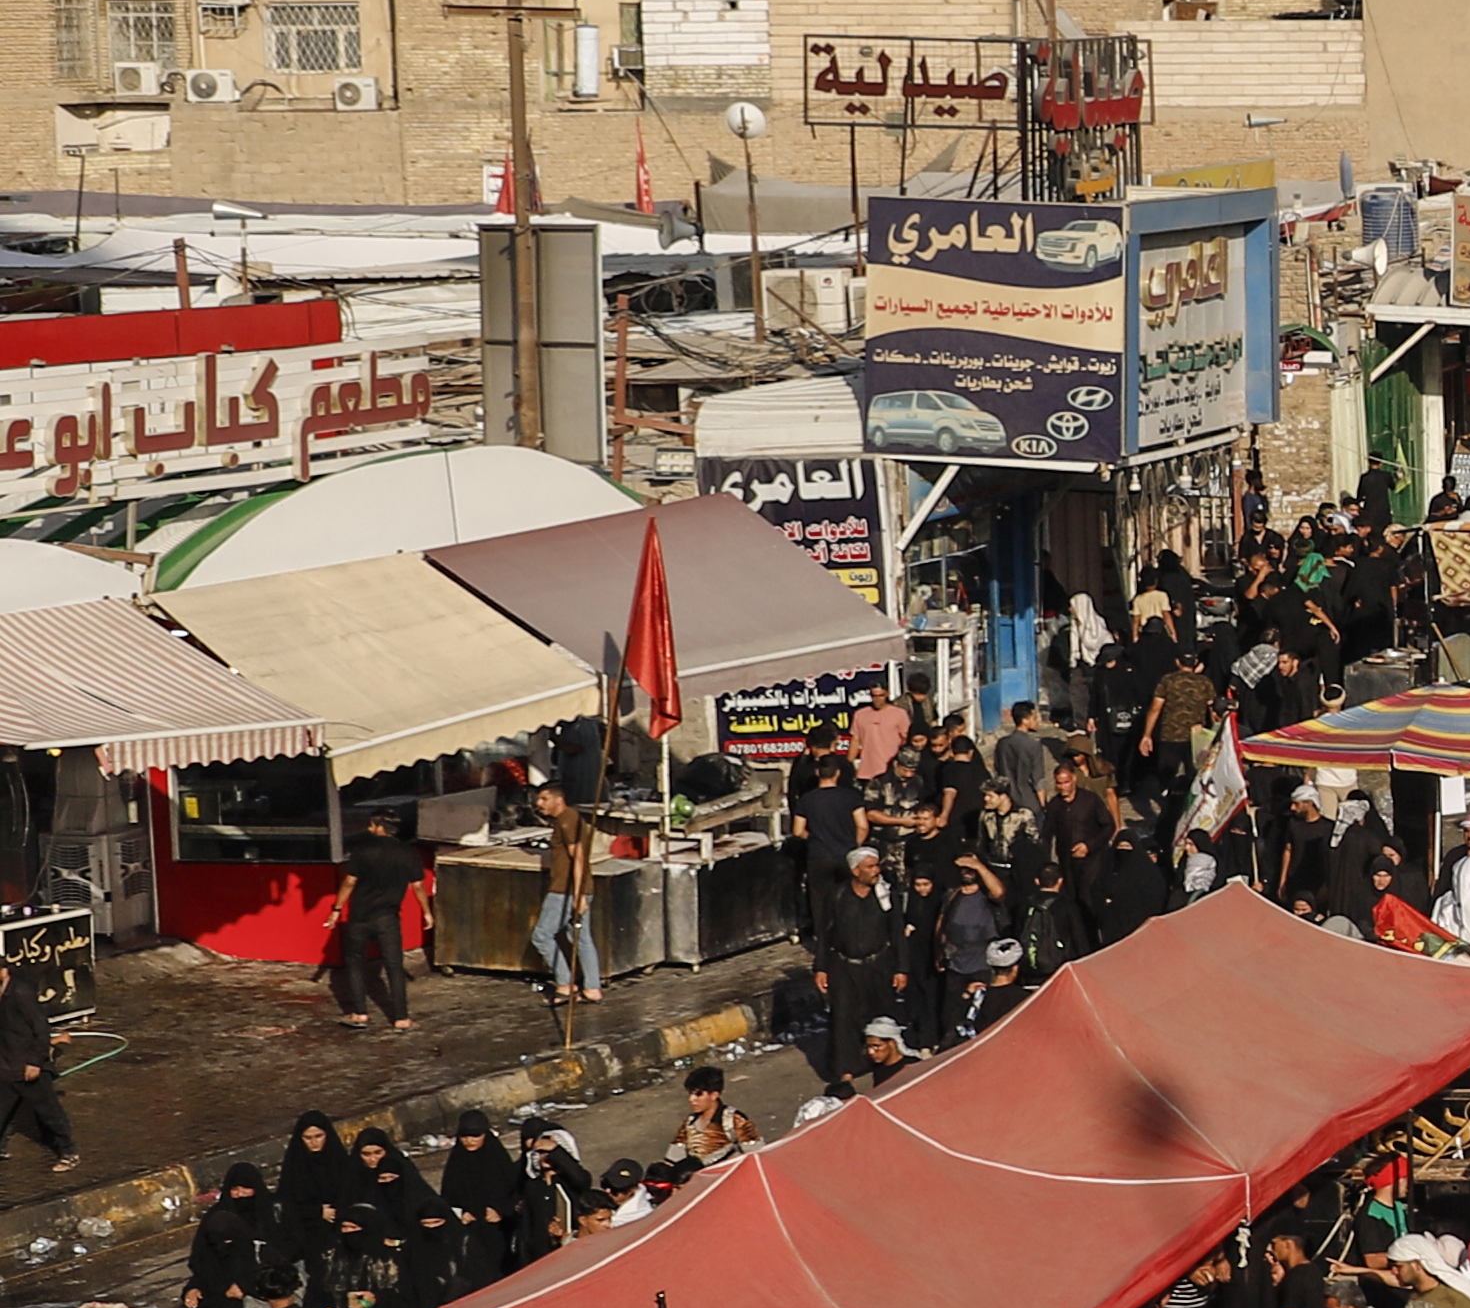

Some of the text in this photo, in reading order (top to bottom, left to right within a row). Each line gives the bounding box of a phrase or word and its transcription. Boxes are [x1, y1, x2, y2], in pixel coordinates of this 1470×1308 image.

[886, 209, 1035, 266] العامري
[873, 295, 934, 317] السيارات
[936, 299, 979, 320] لجميع
[982, 299, 1059, 323] الاحتياطية
[954, 373, 1034, 394] شحن بطاريات
[125, 352, 281, 477] كباب
[292, 350, 434, 483] مطعم
[46, 381, 113, 498] ابو
[1018, 440, 1050, 455] KIA
[791, 686, 846, 709] السيارات
[5, 925, 91, 967] مطعم وكباب
